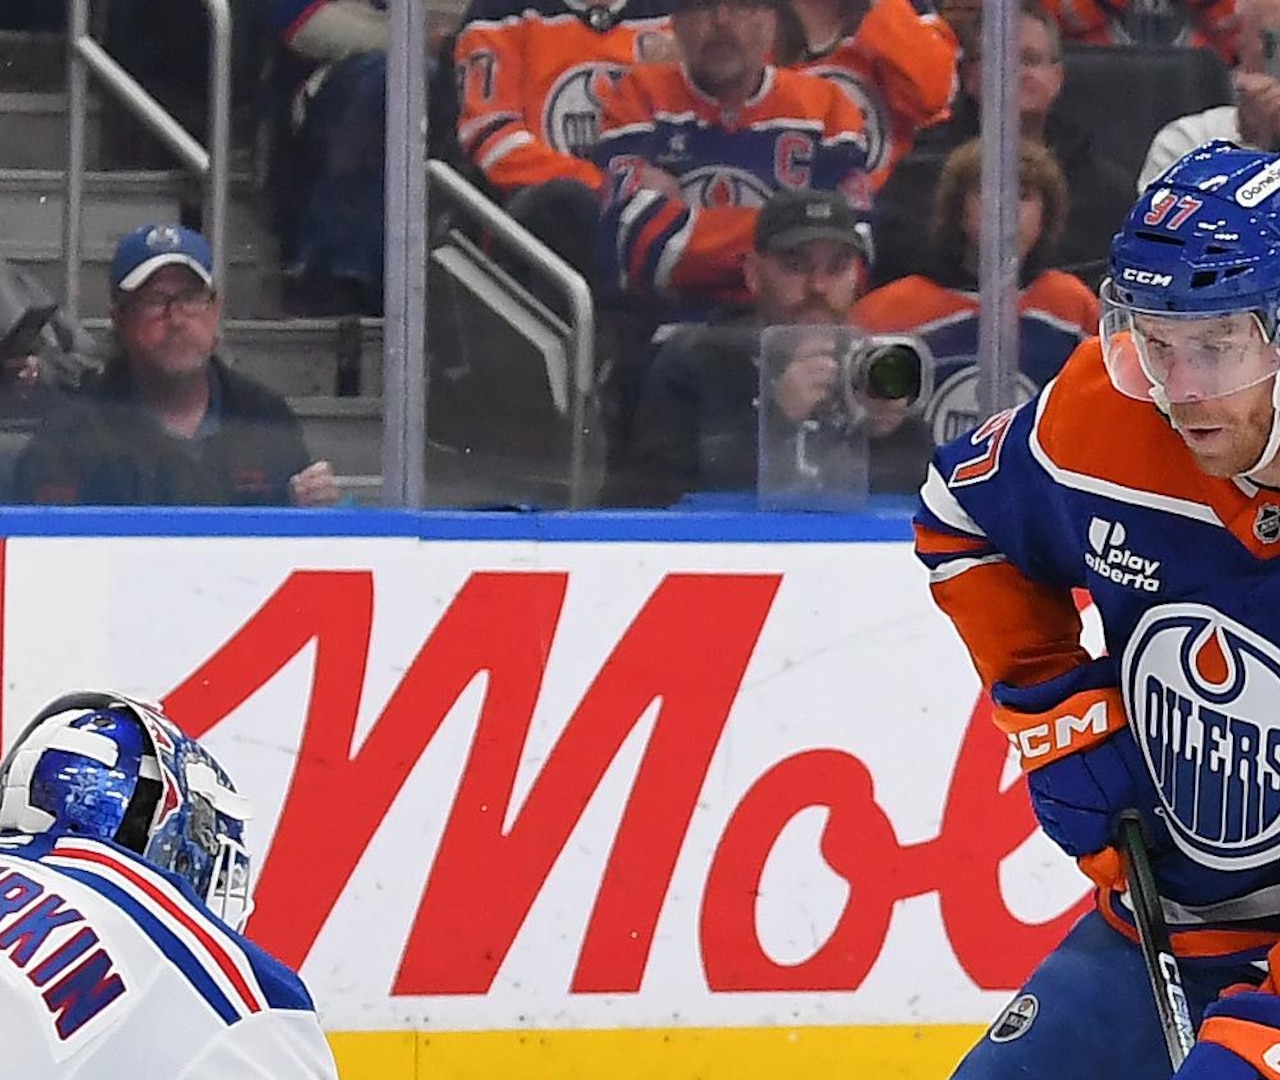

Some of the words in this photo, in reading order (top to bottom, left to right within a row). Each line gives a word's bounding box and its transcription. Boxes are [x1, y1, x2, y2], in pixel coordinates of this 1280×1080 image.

[773, 130, 815, 189] C
[1143, 193, 1203, 231] 97
[1122, 267, 1174, 288] CCM
[1084, 552, 1160, 592] alberta
[1107, 547, 1161, 576] play
